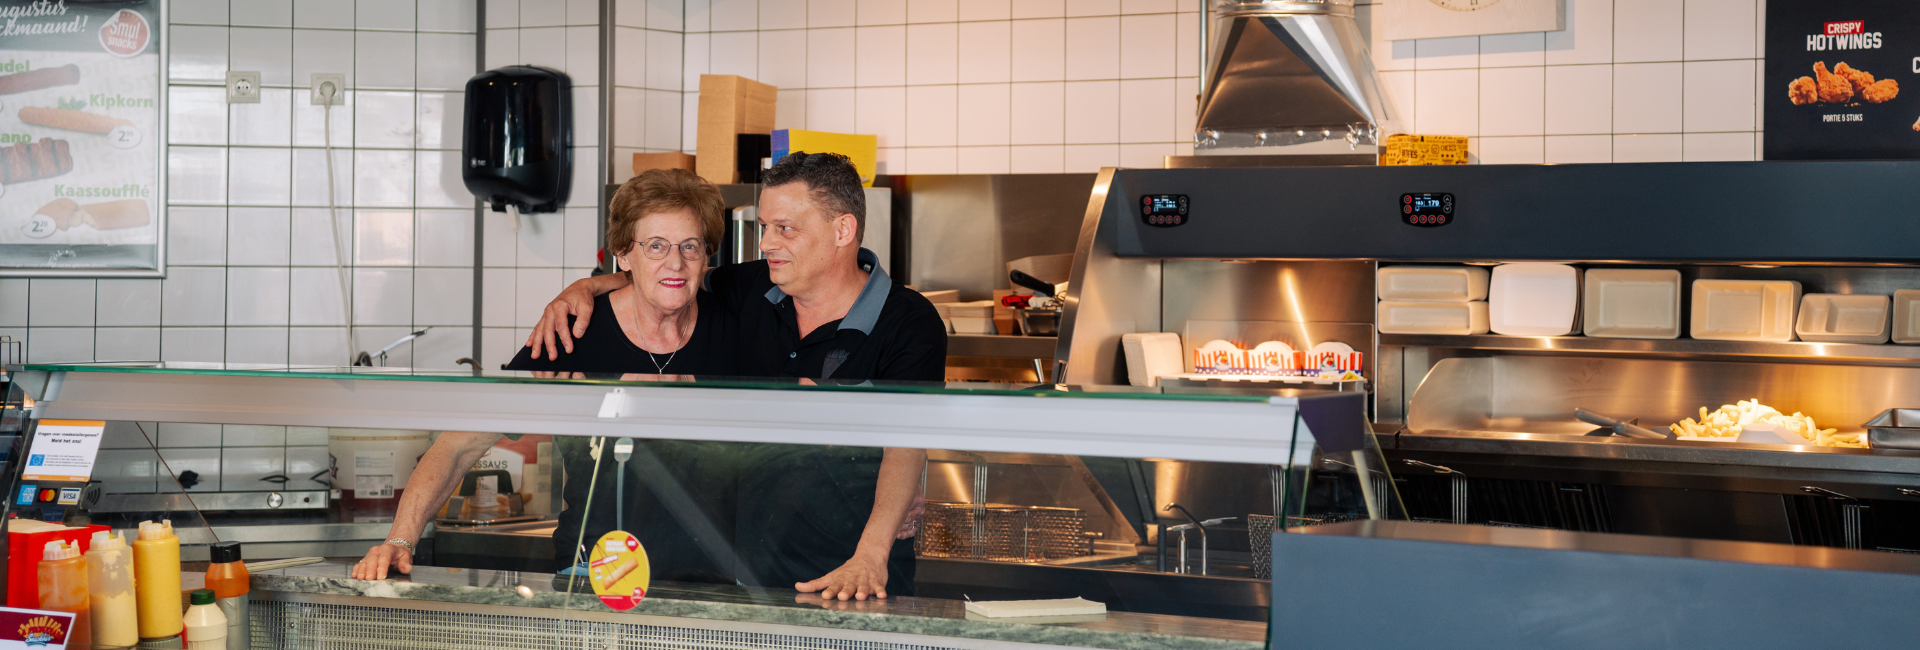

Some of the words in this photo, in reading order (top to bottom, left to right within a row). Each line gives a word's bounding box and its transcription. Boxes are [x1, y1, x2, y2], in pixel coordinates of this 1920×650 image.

[109, 21, 141, 40] Smul
[1827, 22, 1862, 34] CRISPY
[107, 36, 137, 50] snacks
[90, 94, 153, 110] Kipkorn
[1822, 114, 1841, 122] PORTIE
[1842, 114, 1846, 122] 5
[1846, 114, 1863, 122] STUKS
[54, 184, 150, 198] Kaassoufflé
